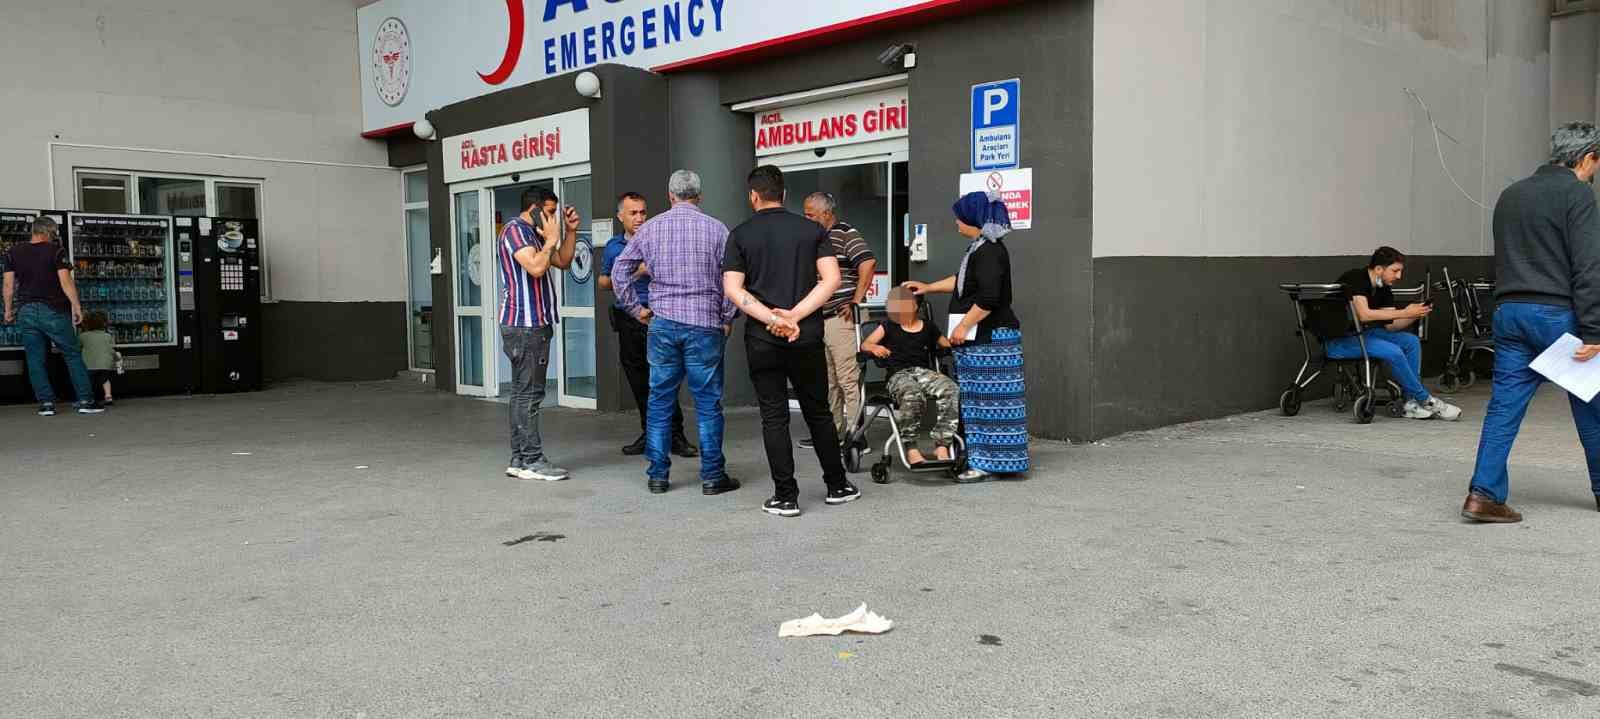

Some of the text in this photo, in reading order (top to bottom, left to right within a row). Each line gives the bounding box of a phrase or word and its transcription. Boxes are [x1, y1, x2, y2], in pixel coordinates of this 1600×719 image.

[544, 0, 725, 75] EMERGENCY
[983, 88, 1009, 125] P
[756, 113, 858, 150] AMBULANS
[979, 133, 1011, 142] Ambulans
[461, 127, 561, 169] HASTA GİRİŞİ
[980, 151, 1010, 160] Park Yeri
[1001, 191, 1022, 200] NDA
[1004, 200, 1029, 209] MEK
